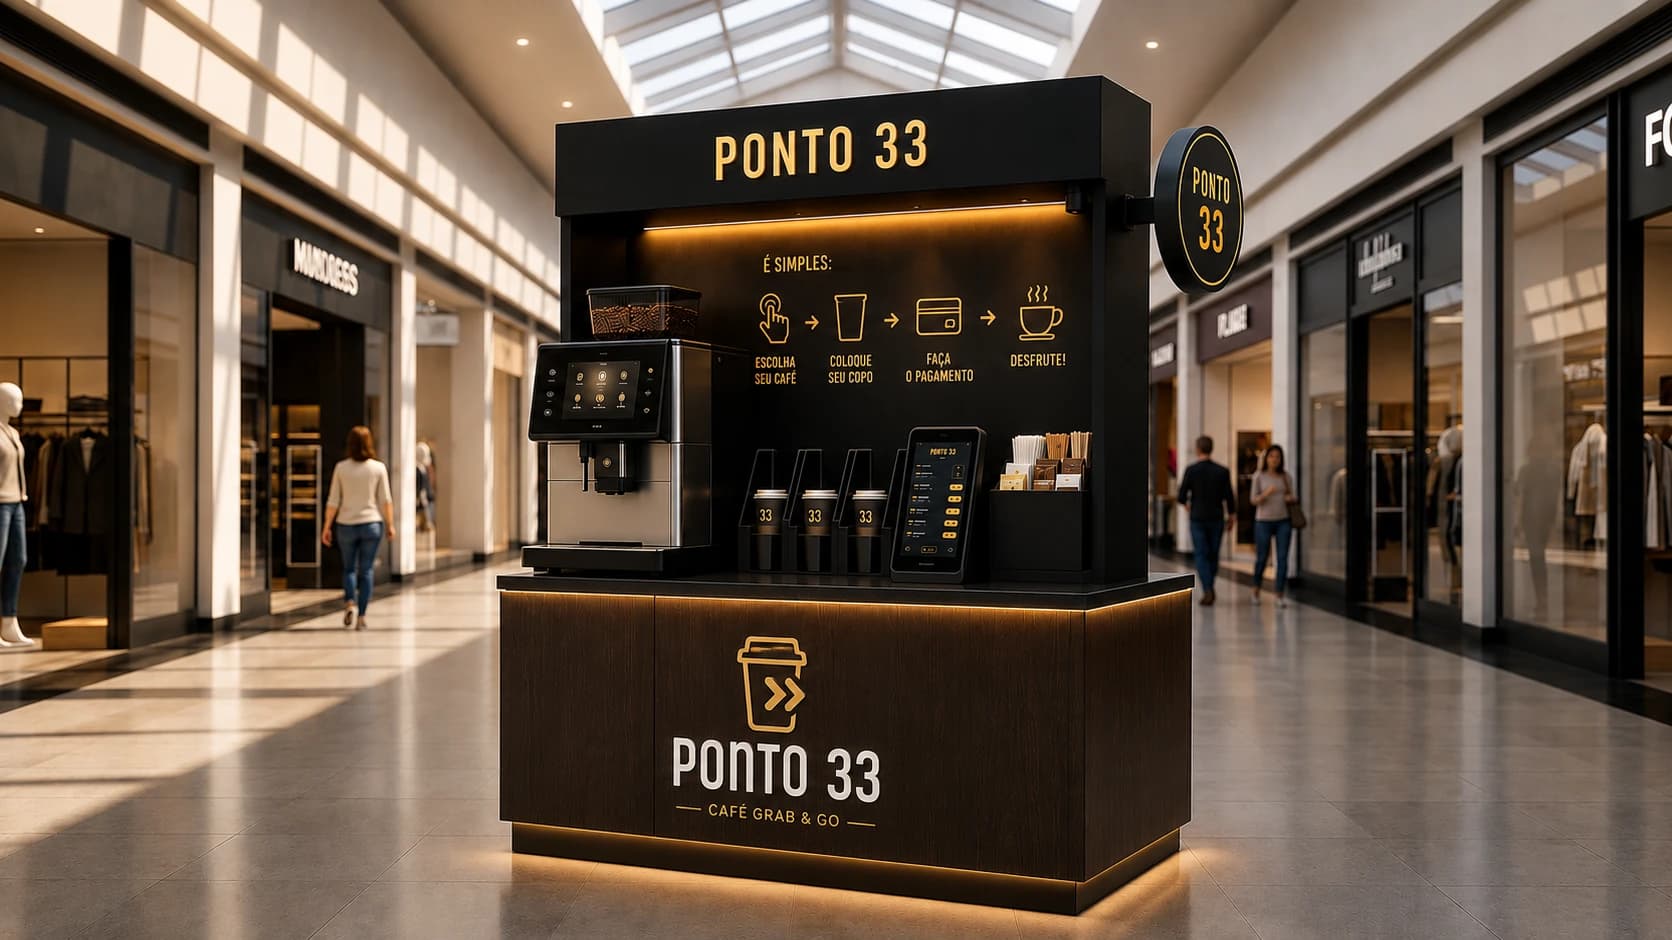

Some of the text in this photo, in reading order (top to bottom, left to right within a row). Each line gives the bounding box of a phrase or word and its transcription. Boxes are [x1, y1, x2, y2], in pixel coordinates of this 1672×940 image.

[715, 119, 927, 181] PONTO 33
[1193, 167, 1230, 204] PONTO
[1200, 205, 1224, 253] 33
[763, 254, 832, 273] É SIMPLES:
[755, 356, 796, 369] ESCOLHA
[829, 354, 872, 368] COLOQUE
[926, 352, 951, 368] FAÇA
[1010, 353, 1066, 367] DESFRUTE!
[754, 370, 797, 384] SEU CAFÉ
[828, 371, 873, 383] SEU COPO
[905, 369, 974, 382] O PAGAMENTO
[760, 509, 773, 521] 33
[808, 509, 822, 523] 33
[859, 510, 873, 524] 33
[827, 748, 880, 803] 33
[708, 803, 840, 827] CAFÉ GRAB & GO
